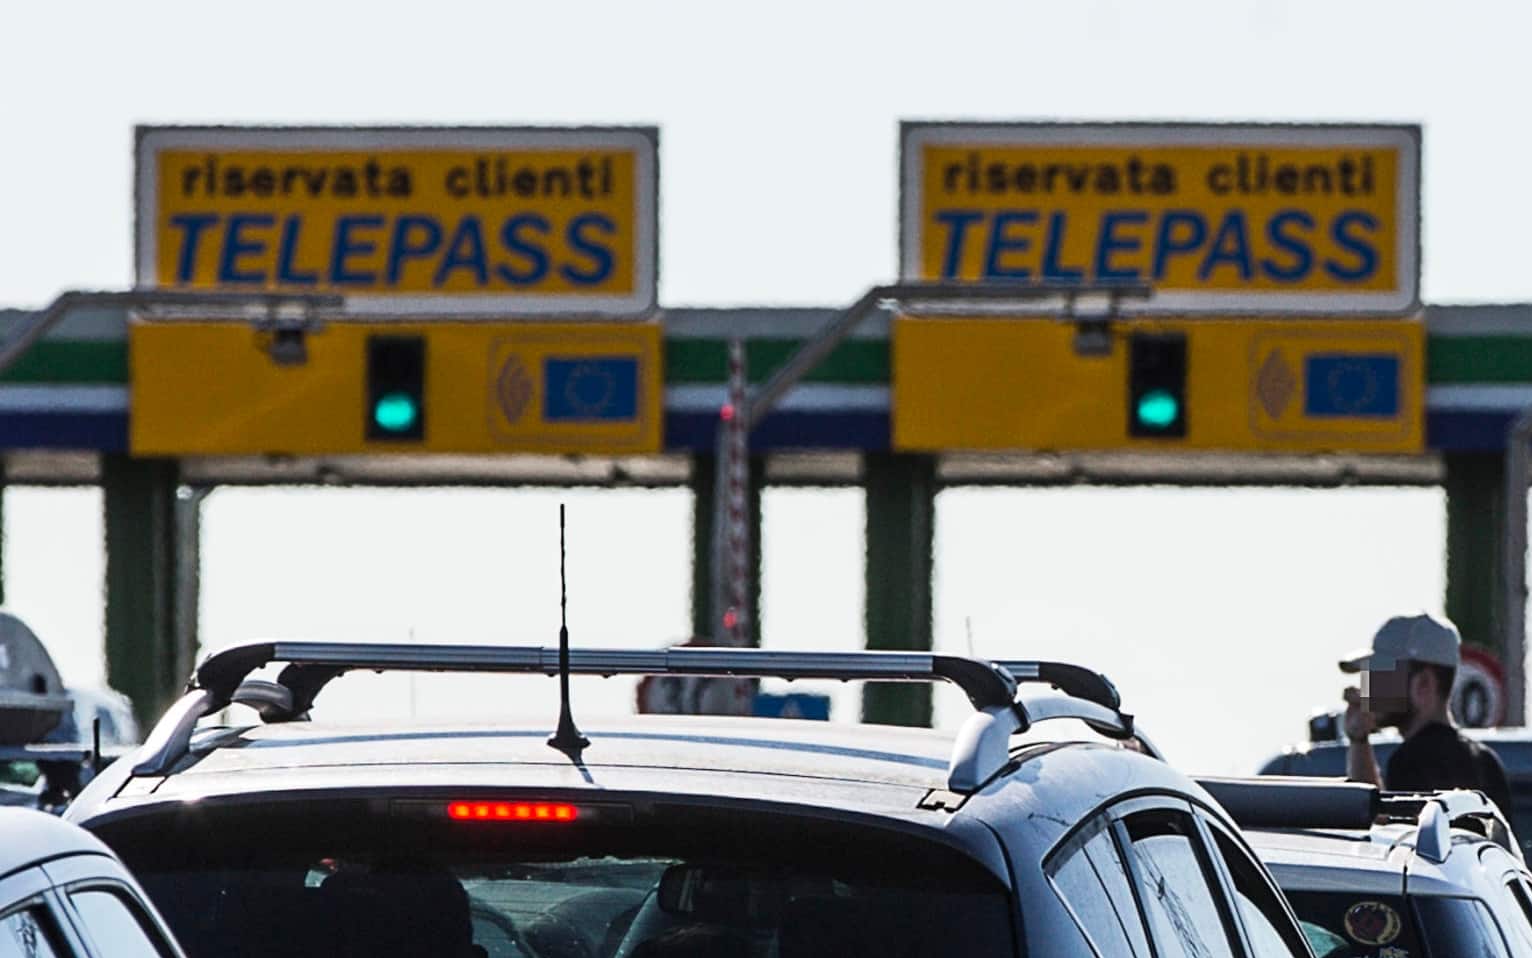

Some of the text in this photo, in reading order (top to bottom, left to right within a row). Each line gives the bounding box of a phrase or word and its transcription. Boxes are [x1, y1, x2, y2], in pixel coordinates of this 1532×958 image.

[182, 155, 615, 198] riservata clienti
[943, 153, 1375, 196] riservata clienti
[169, 212, 619, 288] TELEPASS
[934, 209, 1382, 284] TELEPASS
